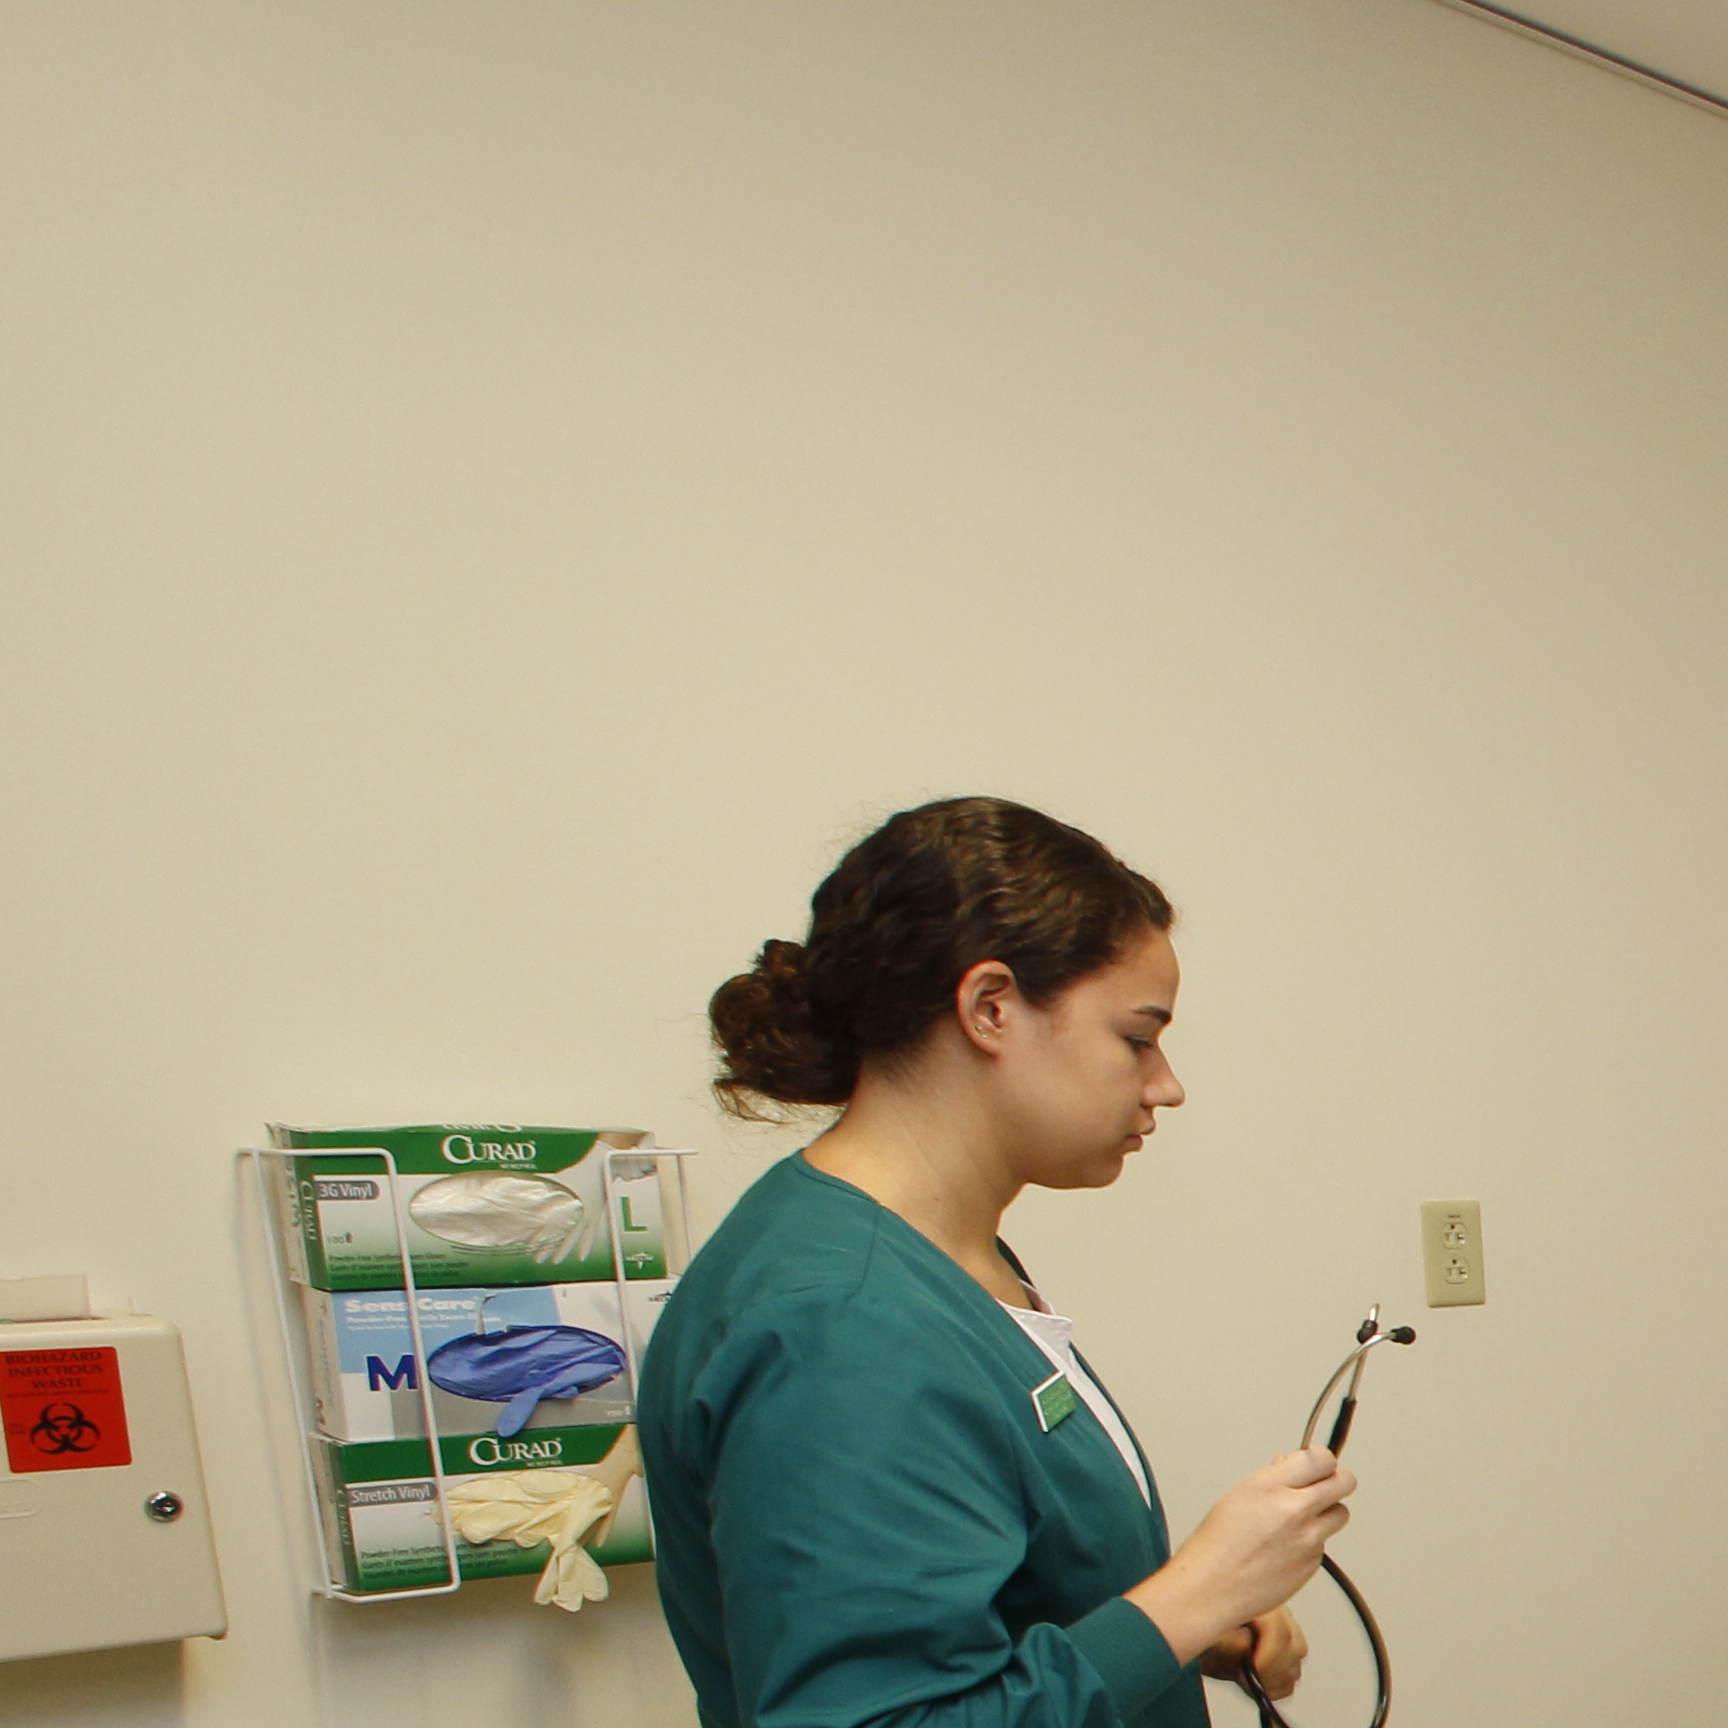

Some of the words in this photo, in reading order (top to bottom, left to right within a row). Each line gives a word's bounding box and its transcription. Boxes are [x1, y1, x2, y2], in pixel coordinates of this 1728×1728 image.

[443, 1134, 537, 1164] CURAD
[341, 1183, 372, 1199] Vinyl
[620, 1196, 648, 1232] L
[344, 1297, 475, 1314] SensCare
[5, 1351, 102, 1364] BIOHAZARD
[9, 1364, 103, 1378] INFECTIOUS
[366, 1354, 418, 1392] M
[470, 1436, 562, 1466] CURAD
[351, 1487, 396, 1502] Stretch
[399, 1484, 431, 1499] Vinyl
